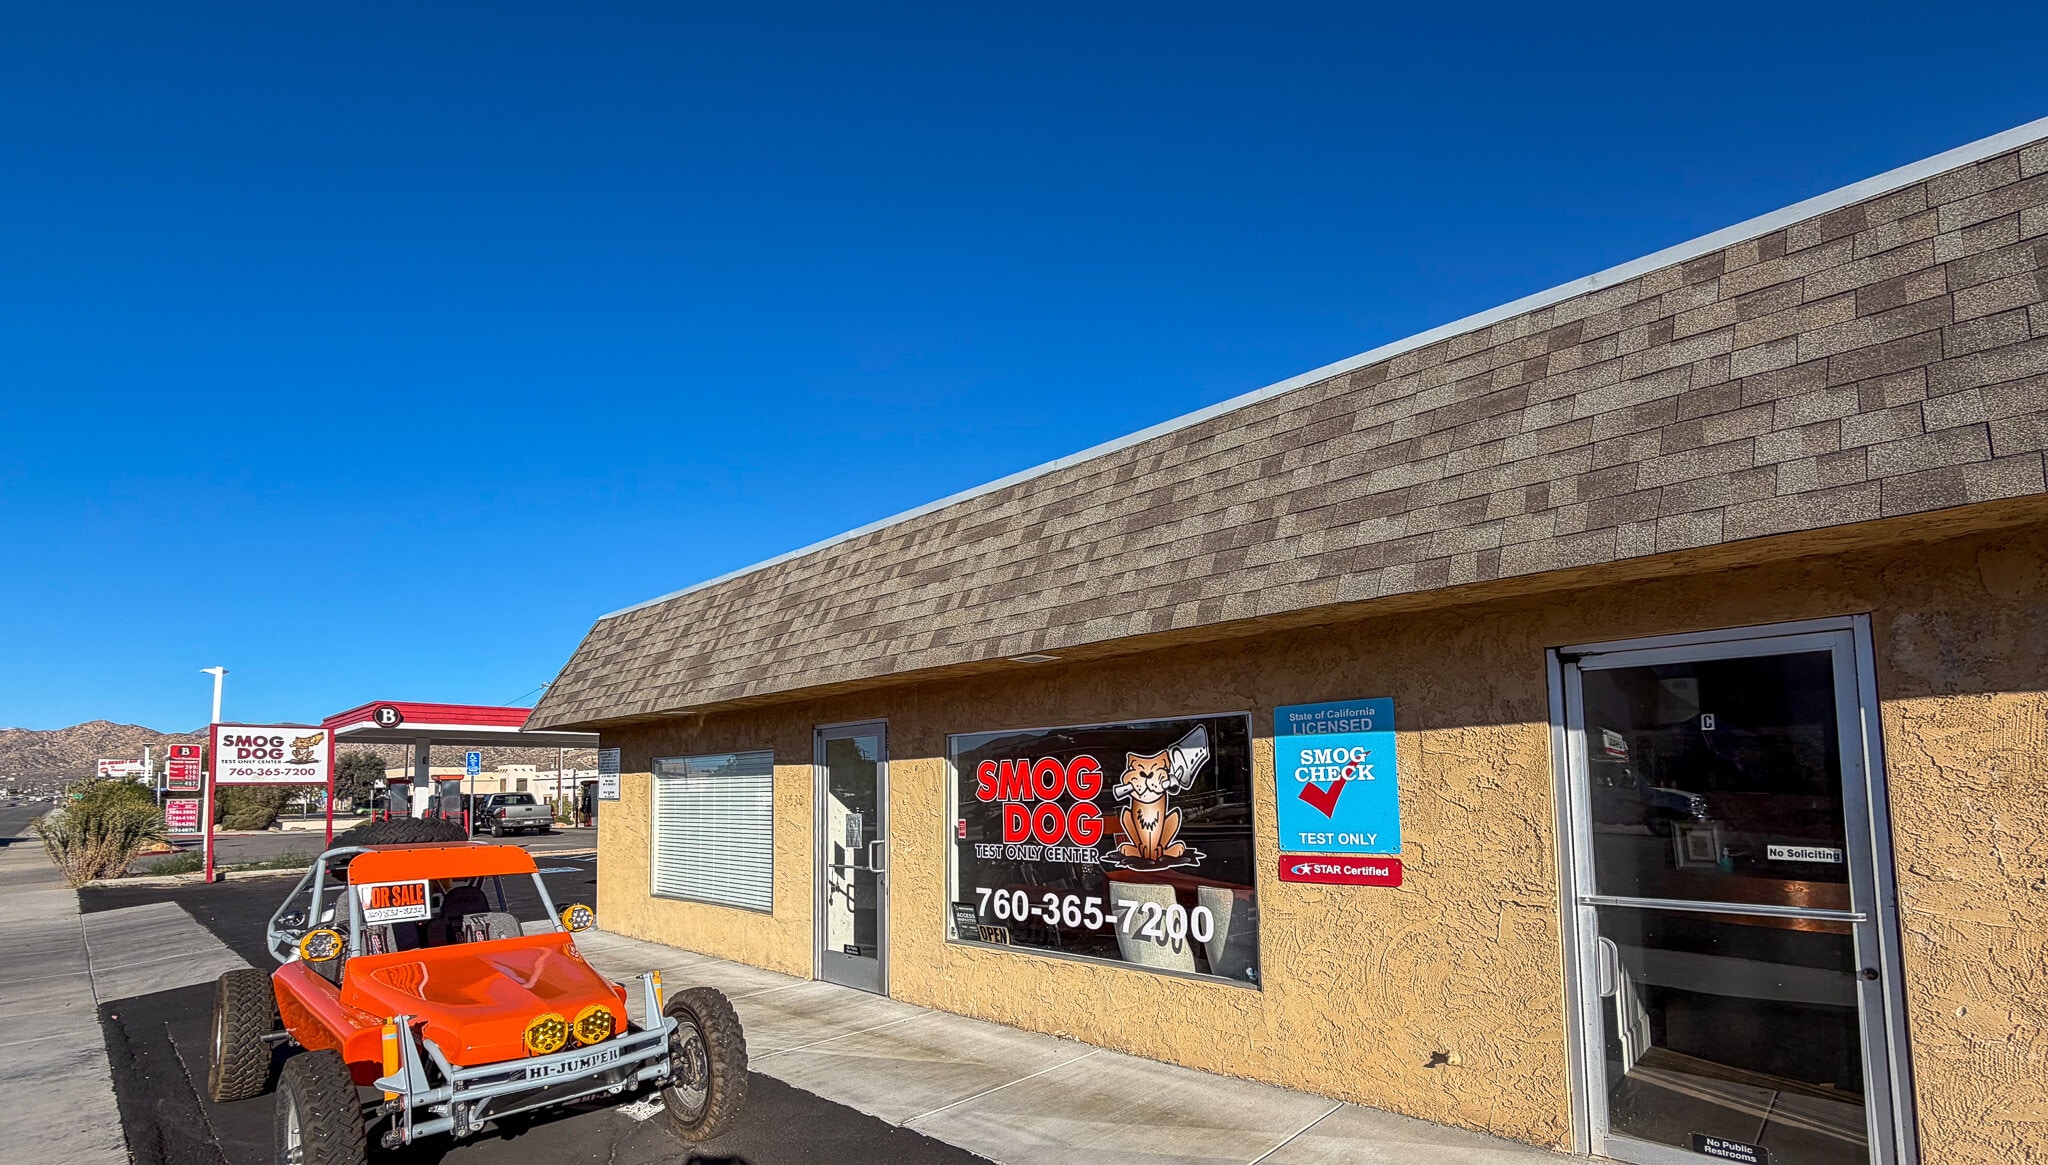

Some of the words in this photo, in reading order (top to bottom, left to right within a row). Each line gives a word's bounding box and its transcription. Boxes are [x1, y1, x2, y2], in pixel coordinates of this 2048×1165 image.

[381, 708, 396, 724] B
[1289, 713, 1313, 722] State
[1314, 710, 1325, 719] of
[1327, 706, 1375, 719] California
[1703, 715, 1712, 729] C
[1292, 718, 1373, 736] LICENSED
[222, 734, 285, 747] SMOG
[181, 747, 190, 756] B
[237, 747, 285, 760] DOG
[1300, 746, 1367, 765] SMOG
[229, 768, 316, 776] 760-365-7200
[975, 755, 1103, 802] SMOG
[1294, 764, 1376, 783] CHECK
[1003, 801, 1104, 847] DOG
[1298, 832, 1334, 845] TEST
[1338, 833, 1378, 846] ONLY
[975, 844, 1003, 858] TEST
[1006, 845, 1043, 861] ONLY
[1045, 846, 1100, 864] CENTER
[1769, 848, 1784, 858] No
[1787, 849, 1841, 862] Soliciting
[1313, 864, 1342, 875] STAR
[1343, 866, 1389, 877] Certified
[366, 887, 390, 909] OR
[391, 884, 424, 906] SALE
[975, 887, 1215, 943] 760-365-7200
[980, 926, 1008, 944] OPEN
[530, 1049, 618, 1079] HI-JUMPER
[1704, 1145, 1757, 1163] Restrooms
[1706, 1138, 1720, 1147] No
[1722, 1141, 1753, 1154] Public
